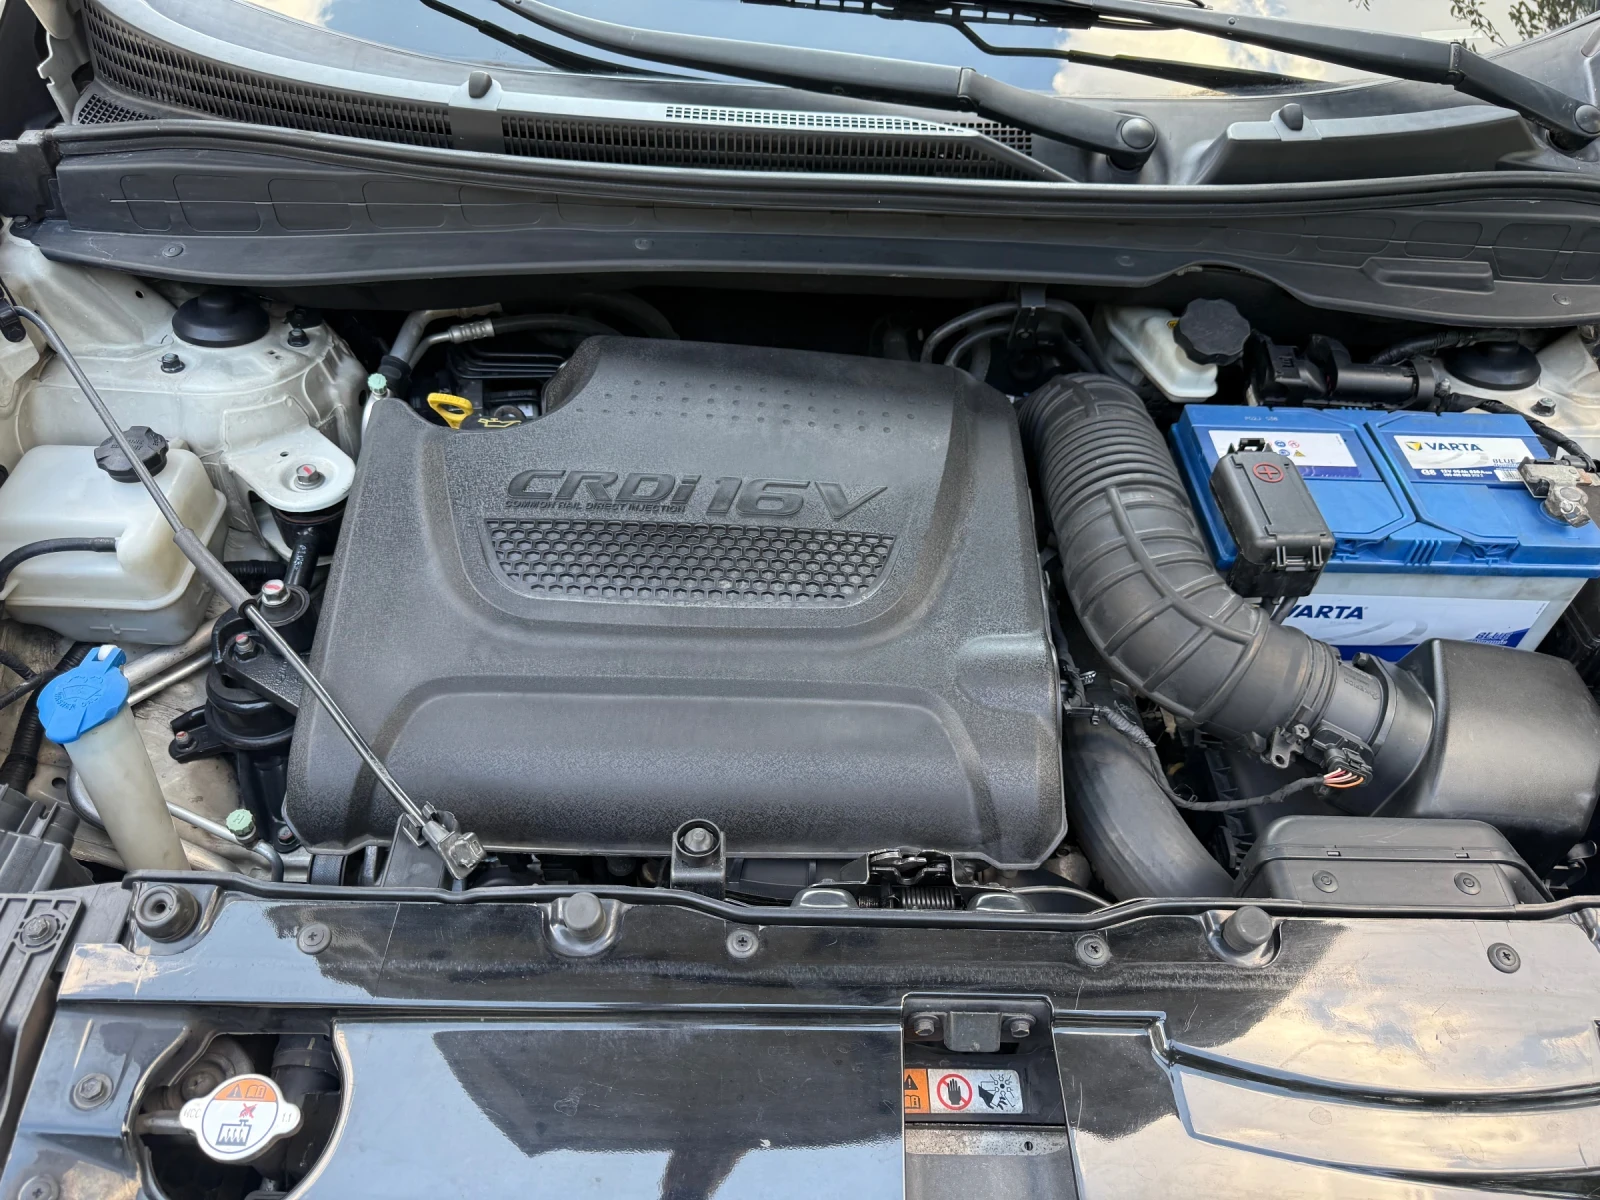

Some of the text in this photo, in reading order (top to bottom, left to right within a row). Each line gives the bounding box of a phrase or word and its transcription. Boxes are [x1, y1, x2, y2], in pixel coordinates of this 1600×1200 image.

[1425, 442, 1483, 451] VARTA
[507, 469, 701, 505] CRDi
[505, 500, 686, 514] COMMON RAIL DIRECT INJECTION
